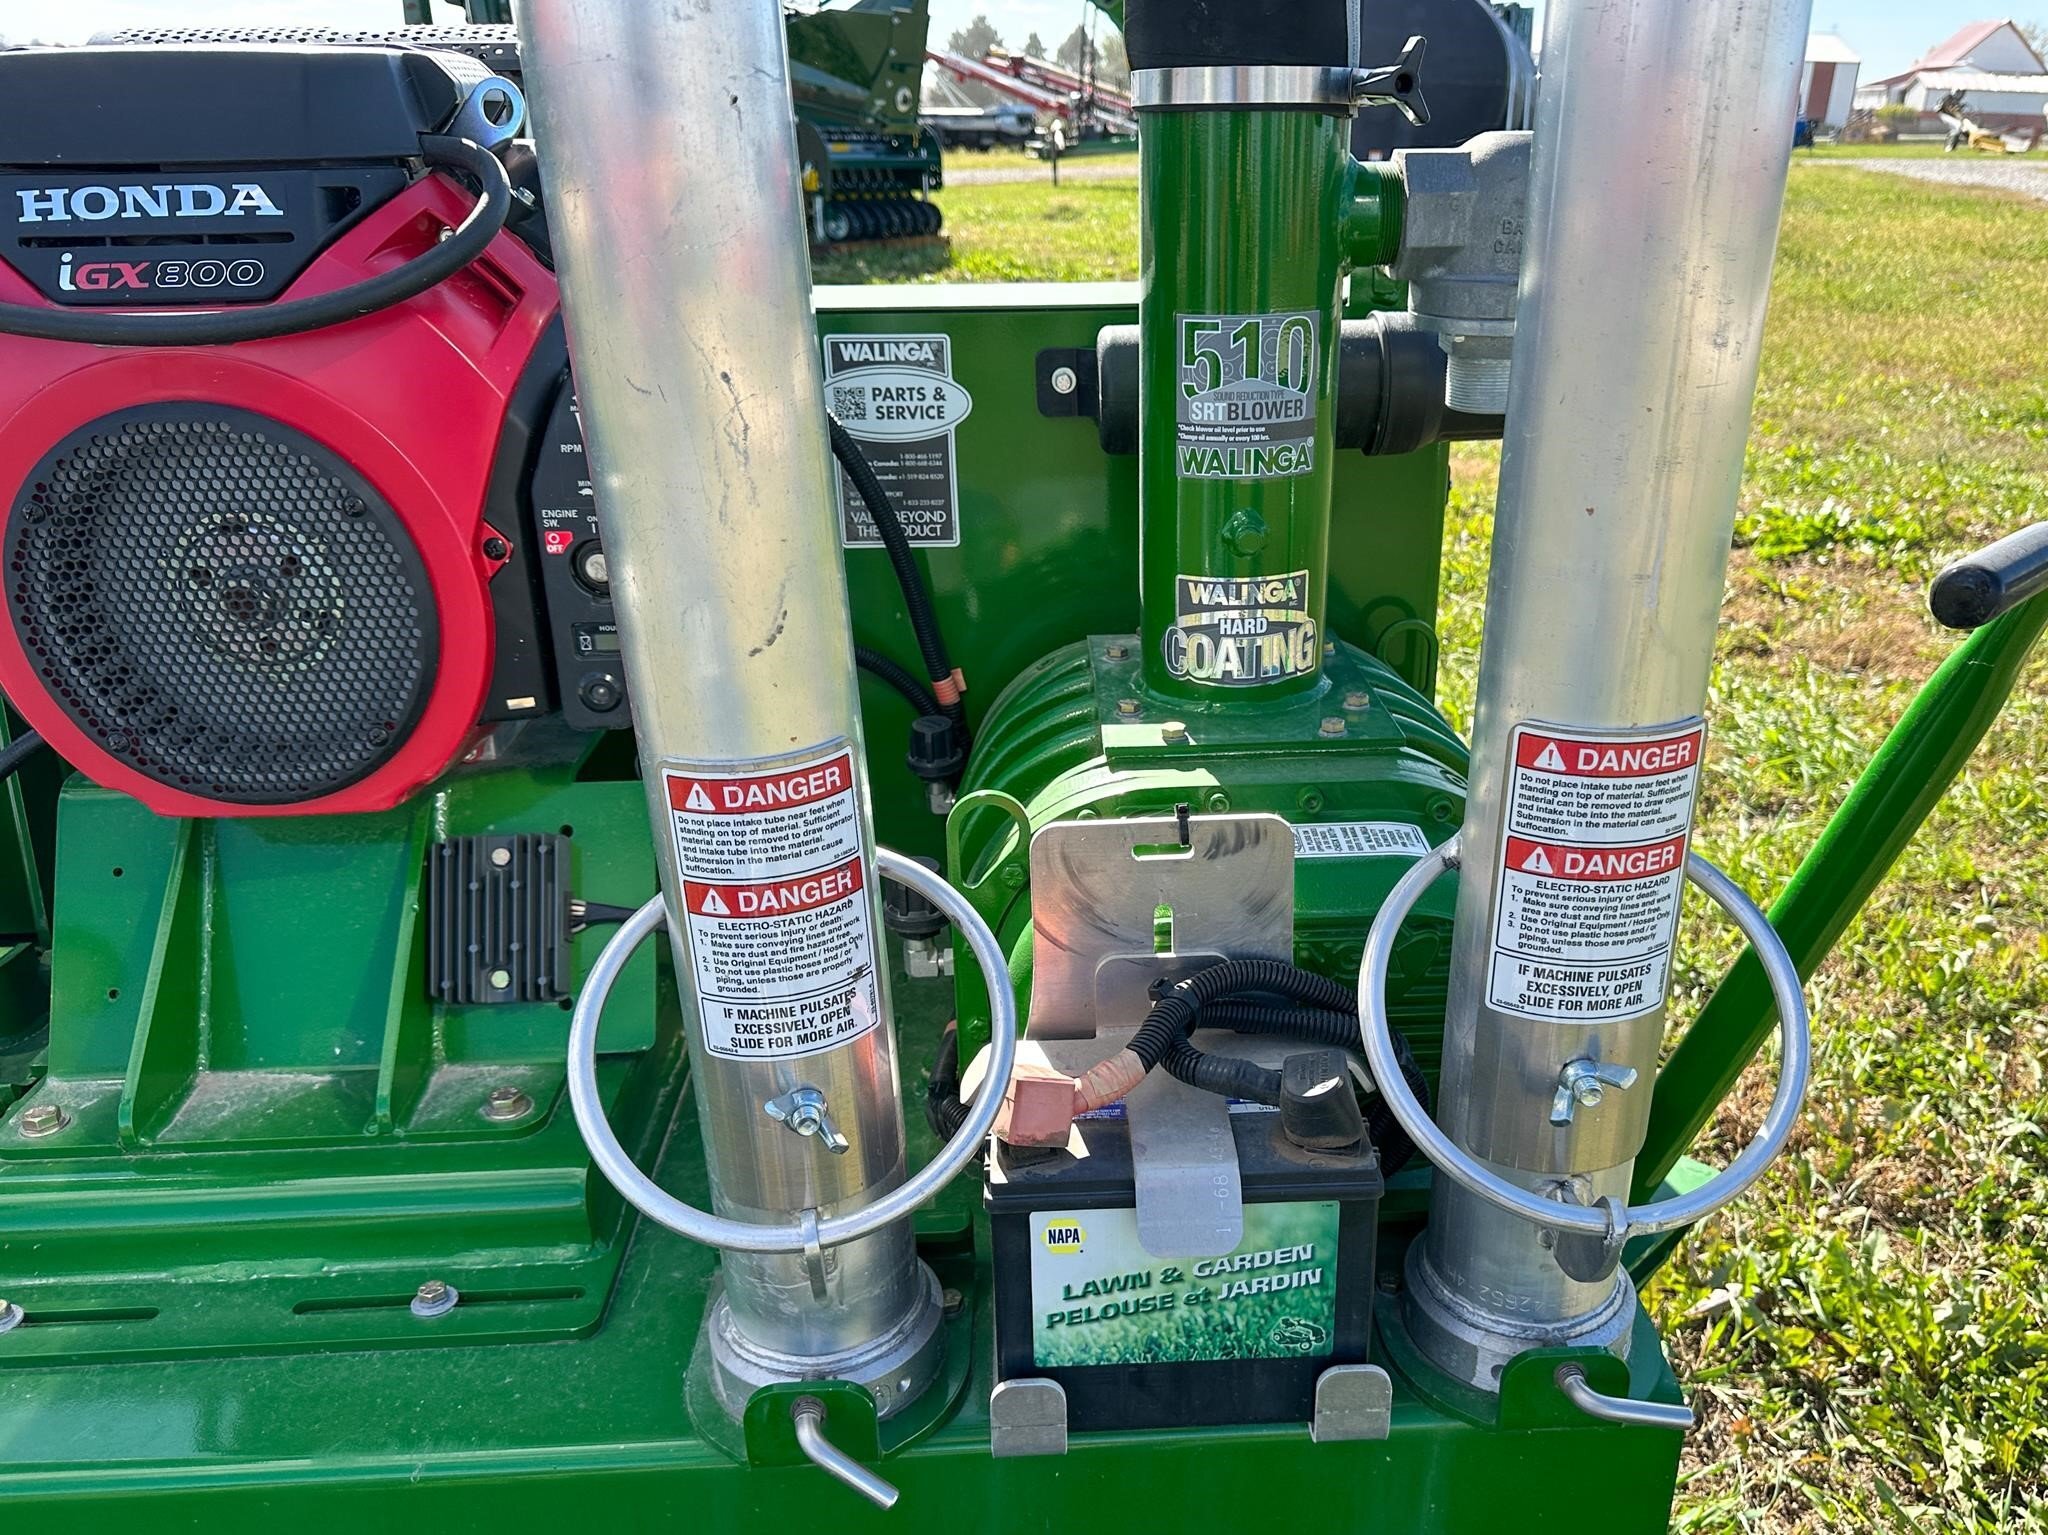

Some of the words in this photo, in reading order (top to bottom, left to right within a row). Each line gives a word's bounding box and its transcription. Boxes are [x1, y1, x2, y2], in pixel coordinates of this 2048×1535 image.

[16, 183, 284, 223] HONDA
[1182, 316, 1314, 400] 510
[872, 387, 926, 402] PARTS
[932, 387, 947, 402] &
[1213, 390, 1234, 400] SOUND
[1235, 390, 1270, 400] REDUCTION
[876, 405, 945, 420] SERVICE
[1206, 434, 1229, 443] annually
[1235, 435, 1250, 443] every
[1236, 426, 1249, 434] prior
[560, 444, 583, 453] RPM
[1178, 442, 1313, 477] WALINGA
[541, 509, 579, 518] ENGINE
[586, 515, 599, 523] ON
[850, 511, 875, 523] VAL
[543, 519, 560, 528] SW.
[857, 525, 881, 537] THE
[546, 544, 564, 553] OFF
[1187, 579, 1298, 606] WALINGA
[1219, 618, 1268, 635] HARD
[1164, 619, 1316, 680] COATING
[1577, 740, 1691, 771] DANGER
[722, 766, 841, 807] DANGER
[677, 815, 689, 824] Do
[706, 819, 731, 827] place
[732, 818, 762, 827] intake
[763, 815, 785, 824] tube
[787, 810, 807, 821] near
[808, 805, 824, 815] feet
[825, 798, 845, 810] when
[679, 826, 715, 837] standing
[730, 829, 746, 838] top
[748, 827, 758, 835] of
[802, 809, 840, 827] Sufficient
[680, 836, 713, 845] material
[733, 838, 746, 846] be
[748, 832, 789, 845] removed
[802, 825, 823, 837] draw
[824, 813, 853, 830] operator
[1515, 820, 1568, 835] suffocation.
[682, 845, 697, 853] and
[698, 846, 725, 855] intake
[726, 847, 747, 855] tube
[749, 846, 768, 854] into
[770, 844, 785, 852] the
[683, 853, 734, 865] Submersion
[747, 856, 763, 864] the
[765, 849, 802, 862] material
[803, 846, 819, 855] can
[820, 837, 843, 851] cause
[1564, 844, 1675, 875] DANGER
[685, 864, 734, 874] suffocation.
[737, 868, 852, 913] DANGER
[1536, 879, 1632, 894] ELECTRO-STATIC
[1633, 875, 1669, 891] HAZARD
[717, 913, 812, 931] ELECTRO-STATIC
[814, 899, 853, 920] HAZARD
[1520, 913, 1538, 923] Use
[1539, 917, 1576, 928] Original
[1578, 921, 1626, 930] Equipment
[1632, 916, 1655, 926] Hoses
[697, 928, 708, 937] To
[710, 932, 742, 940] prevent
[744, 931, 778, 940] serious
[780, 926, 806, 937] injury
[808, 923, 817, 931] or
[710, 939, 732, 949] Make
[756, 936, 803, 948] conveying
[805, 930, 826, 941] lines
[827, 923, 842, 935] and
[843, 915, 860, 928] work
[770, 947, 787, 956] and
[789, 945, 804, 953] fire
[806, 935, 834, 950] hazard
[1517, 941, 1563, 953] grounded.
[1518, 963, 1530, 975] IF
[1532, 966, 1594, 982] MACHINE
[1597, 963, 1651, 982] PULSATES
[1613, 979, 1642, 995] OPEN
[1517, 993, 1554, 1009] SLIDE
[1557, 999, 1582, 1011] FOR
[1586, 997, 1622, 1011] MORE
[723, 1007, 733, 1019] IF
[736, 1005, 796, 1020] MACHINE
[820, 1005, 850, 1024] OPEN
[730, 1036, 764, 1048] SLIDE
[767, 1035, 793, 1048] FOR
[796, 1026, 833, 1045] MORE
[1047, 1227, 1080, 1245] NAPA
[1062, 1269, 1151, 1301] LAWN
[1159, 1266, 1185, 1284] &
[1191, 1242, 1315, 1278] GARDEN
[1045, 1292, 1175, 1329] PELOUSE
[1181, 1286, 1212, 1306] et
[1216, 1267, 1323, 1301] JARDIN
